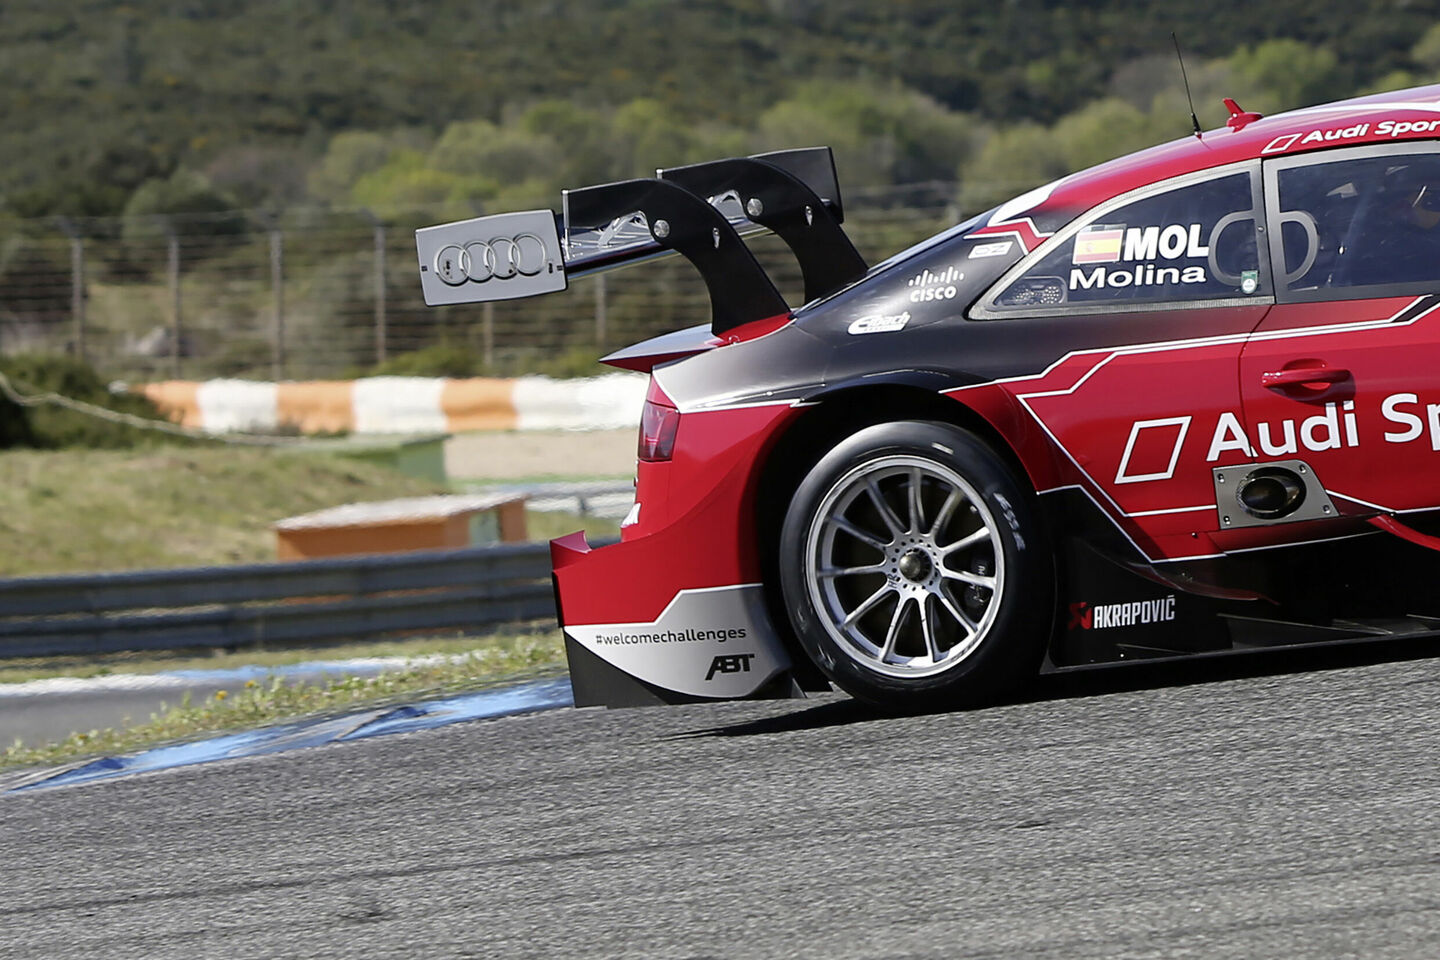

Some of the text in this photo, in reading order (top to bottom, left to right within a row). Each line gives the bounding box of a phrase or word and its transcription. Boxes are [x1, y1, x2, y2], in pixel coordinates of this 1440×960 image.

[1301, 124, 1370, 144] Audi
[1123, 224, 1210, 262] MOL
[1069, 264, 1207, 290] Molina
[910, 285, 957, 303] cisco
[1206, 400, 1360, 462] Audi
[595, 628, 747, 645] #welcomechallenges
[705, 653, 755, 681] ABT
